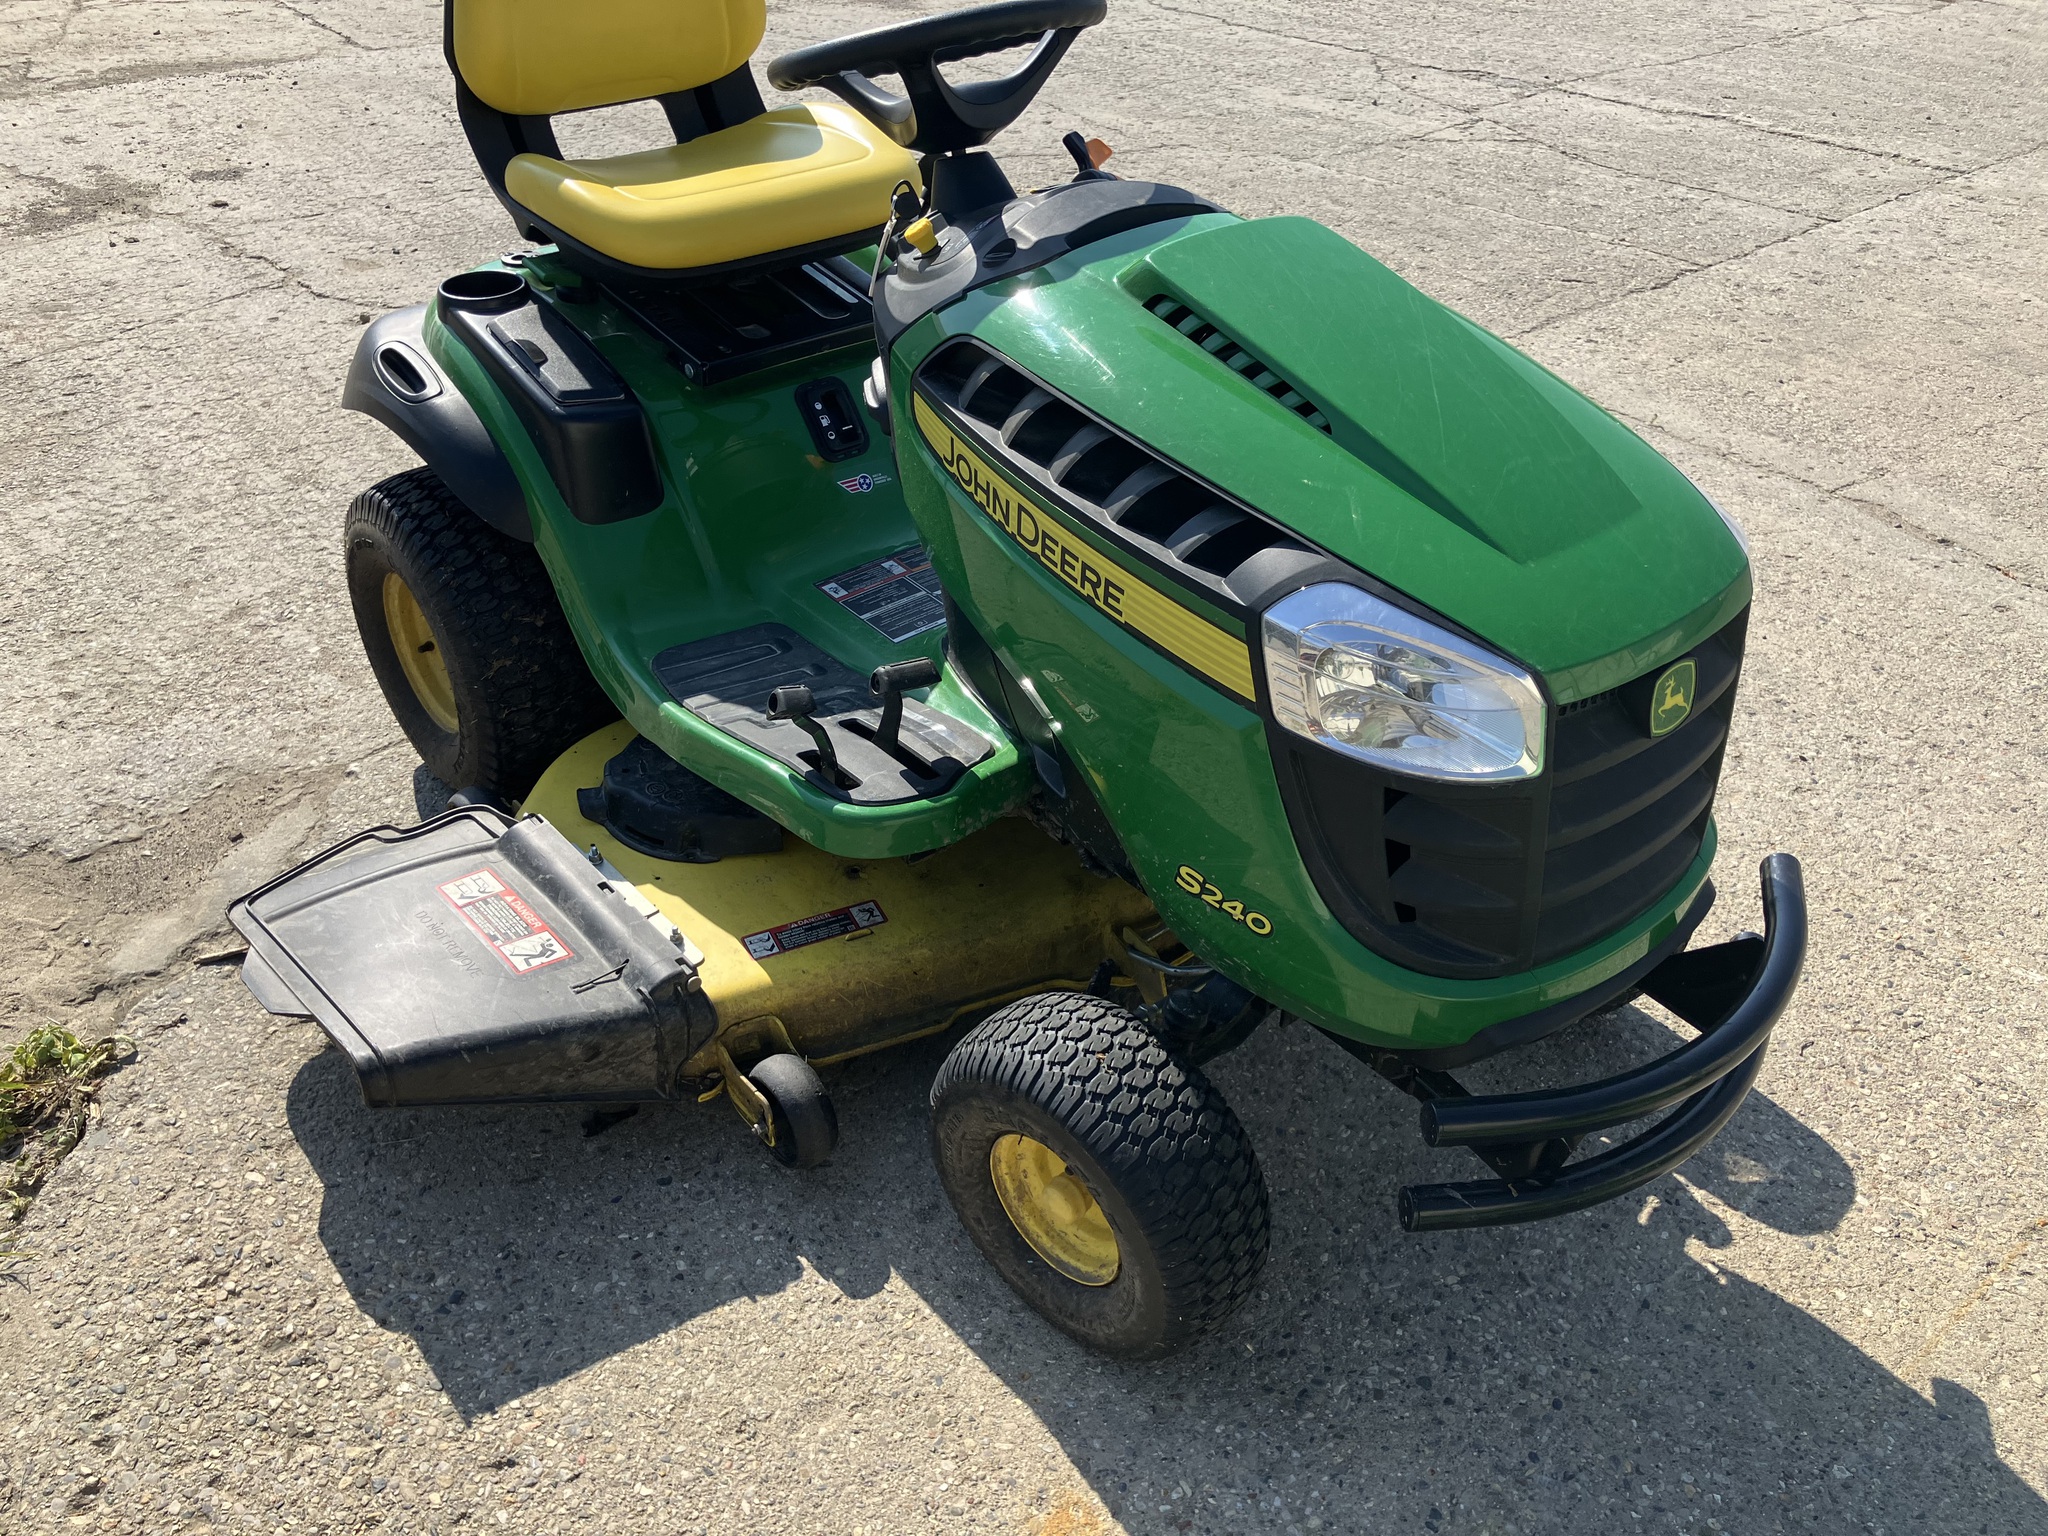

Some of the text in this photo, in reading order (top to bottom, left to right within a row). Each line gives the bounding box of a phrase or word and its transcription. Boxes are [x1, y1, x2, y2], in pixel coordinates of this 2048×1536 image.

[943, 436, 1011, 528] JOHN
[1016, 503, 1125, 617] DEERE
[510, 900, 542, 928] DANGER
[797, 913, 832, 926] DANGER
[1175, 865, 1272, 936] S240
[414, 910, 485, 979] DO NOT REMOVE
